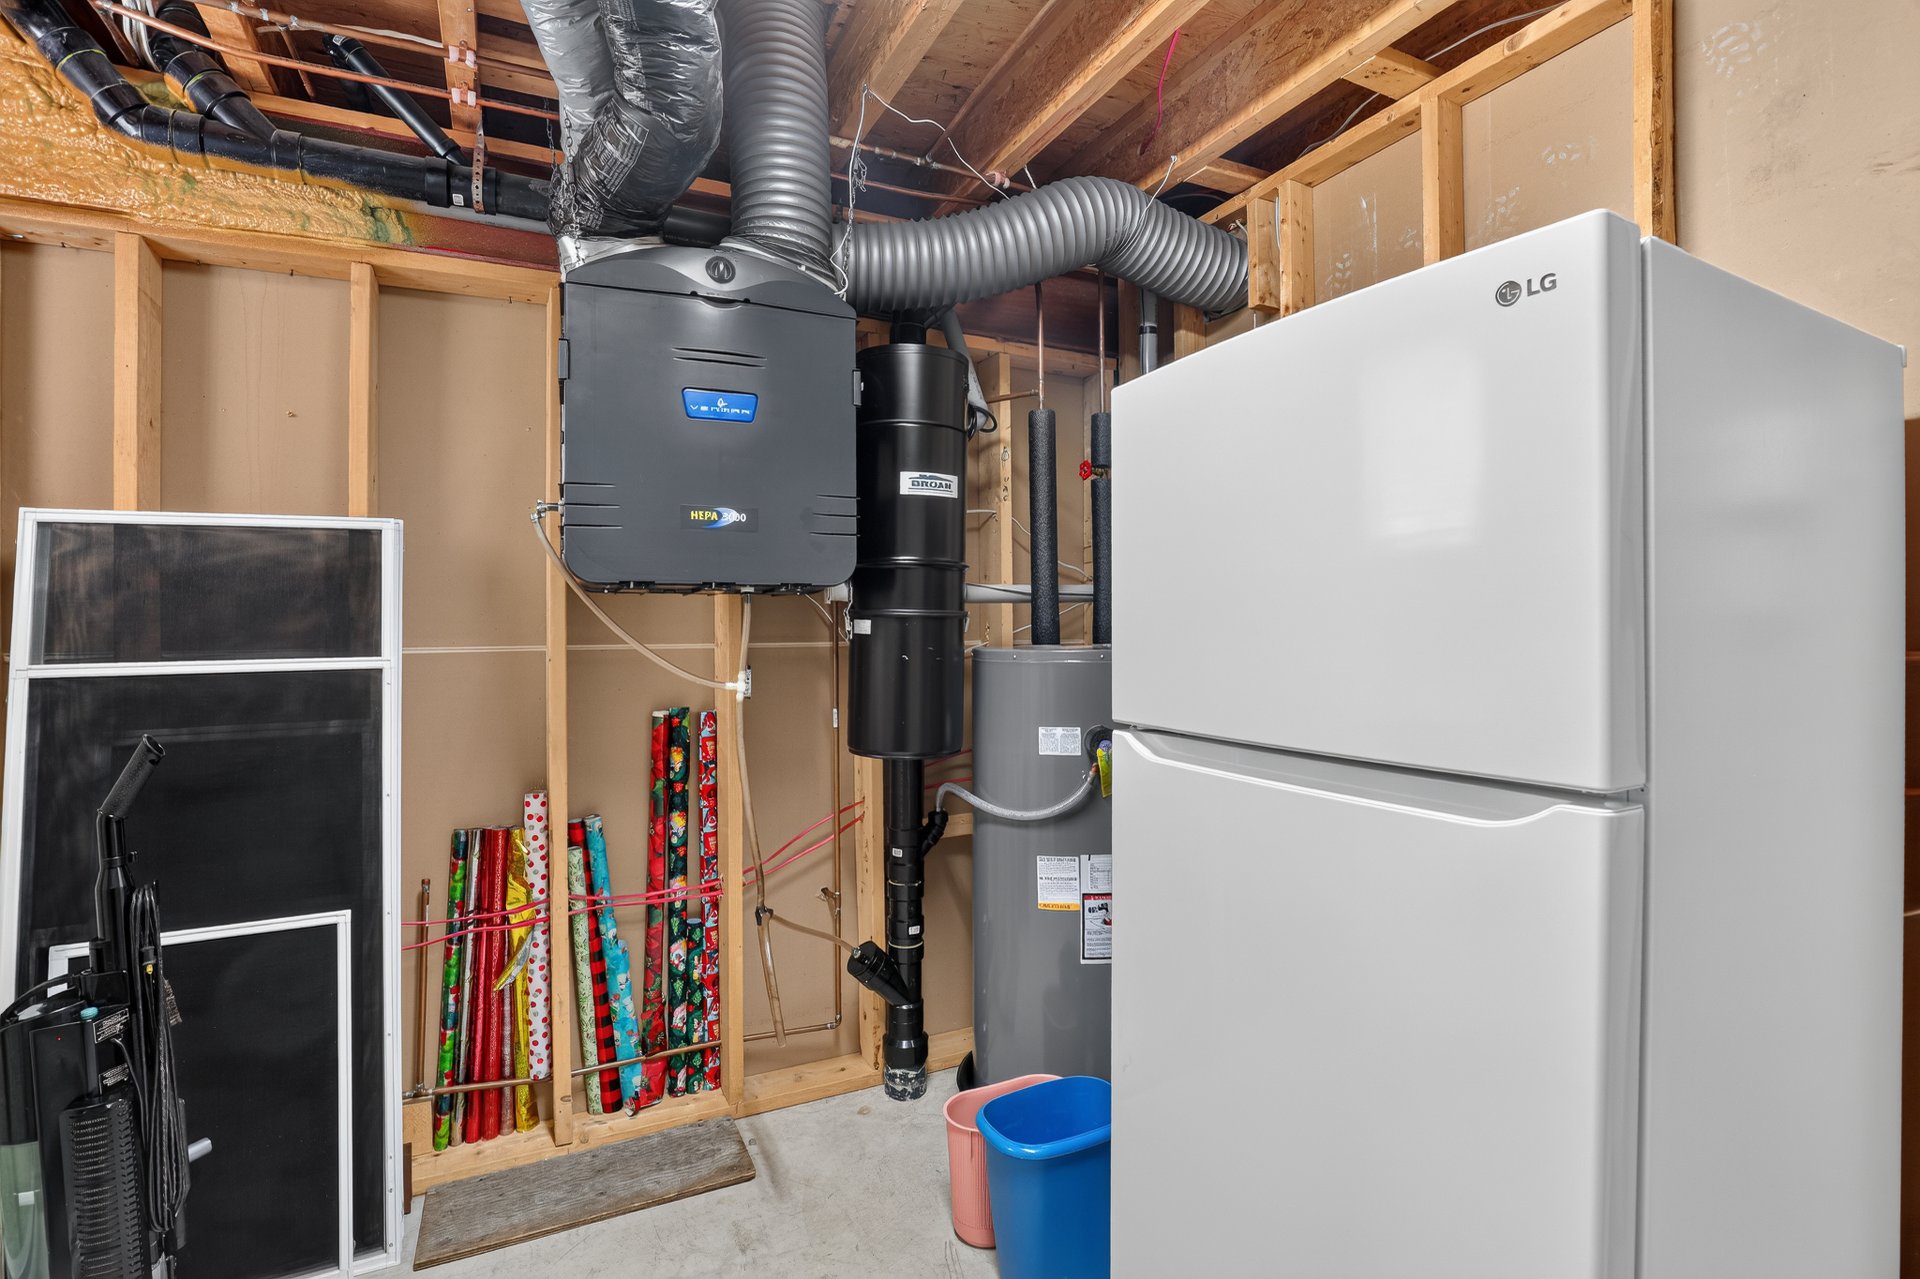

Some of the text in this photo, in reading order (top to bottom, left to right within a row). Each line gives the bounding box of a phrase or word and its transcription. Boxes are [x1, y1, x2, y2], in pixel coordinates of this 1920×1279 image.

[1526, 272, 1557, 297] LG
[911, 479, 952, 490] BROAN
[690, 510, 747, 523] HEPA 3000
